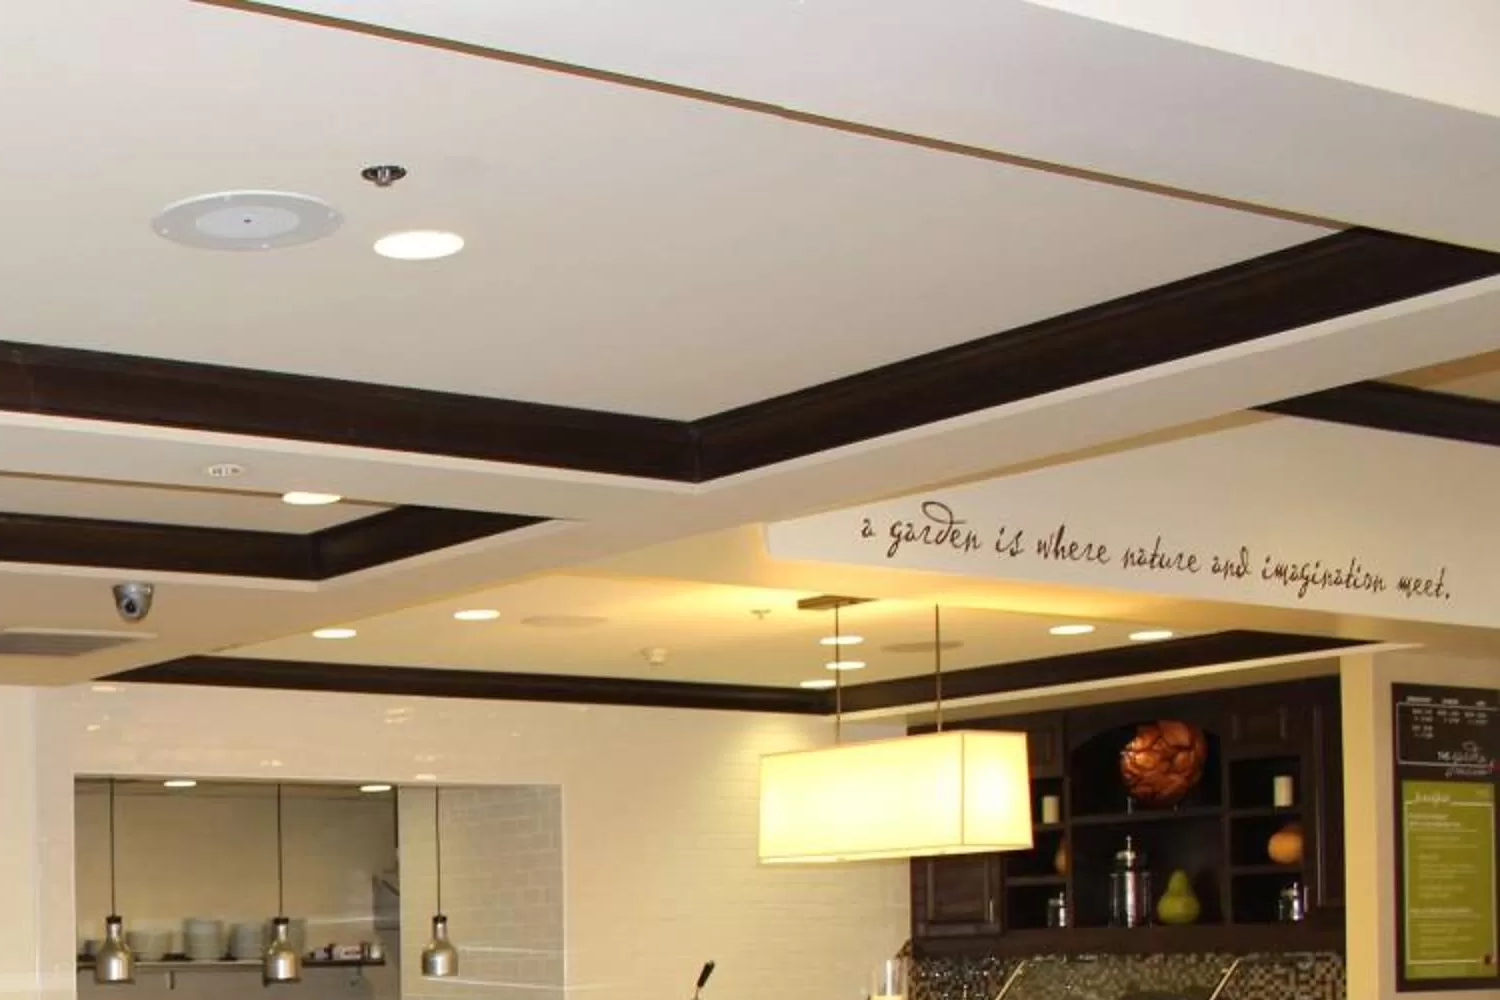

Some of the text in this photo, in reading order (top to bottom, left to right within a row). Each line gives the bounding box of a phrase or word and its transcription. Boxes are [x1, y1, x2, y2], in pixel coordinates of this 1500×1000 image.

[861, 500, 1452, 601] a garden is where nature and imagination meet.
